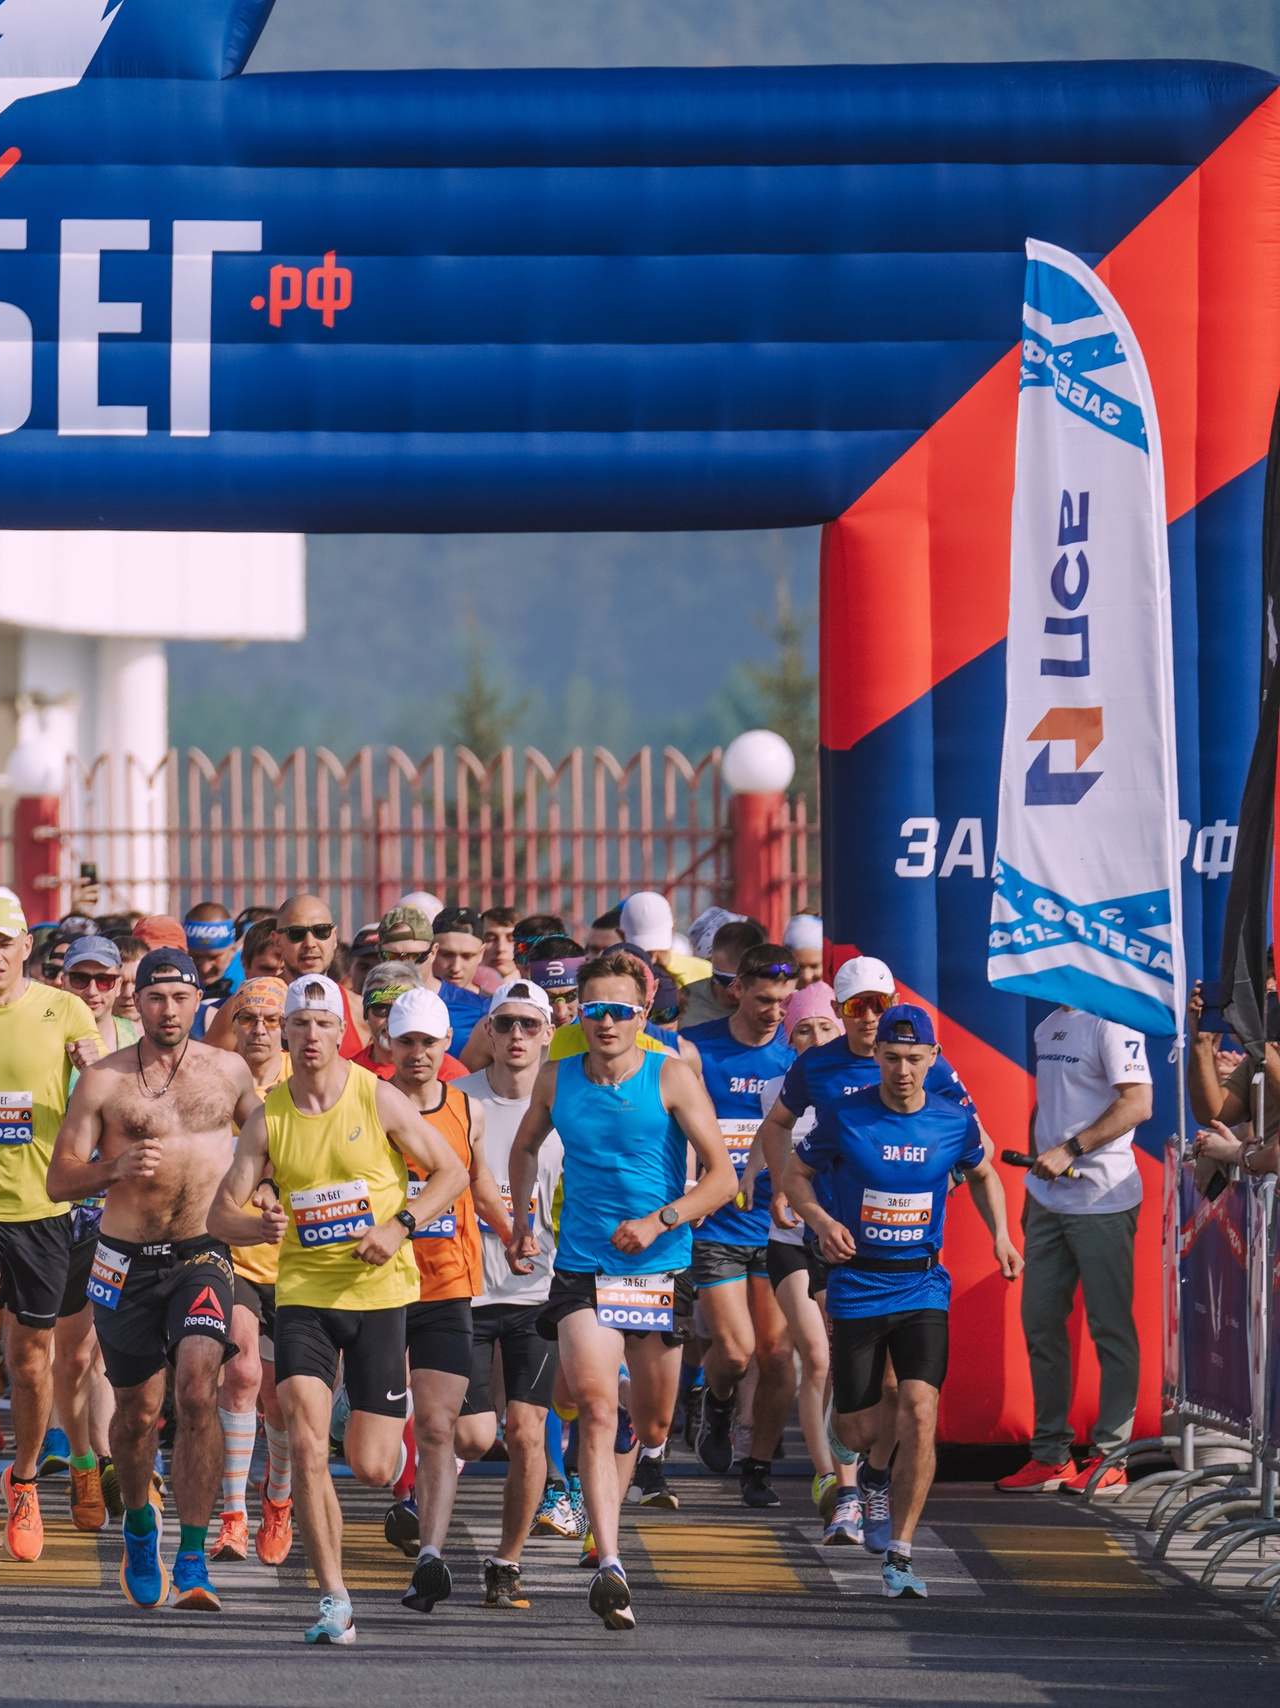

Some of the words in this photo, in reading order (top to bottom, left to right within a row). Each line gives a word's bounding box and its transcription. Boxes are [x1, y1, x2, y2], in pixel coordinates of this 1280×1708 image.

[1124, 1041, 1140, 1059] 7
[303, 1218, 369, 1242] 00214
[865, 1226, 924, 1242] 00198
[183, 1315, 227, 1334] Reebok
[599, 1308, 671, 1326] 00044
